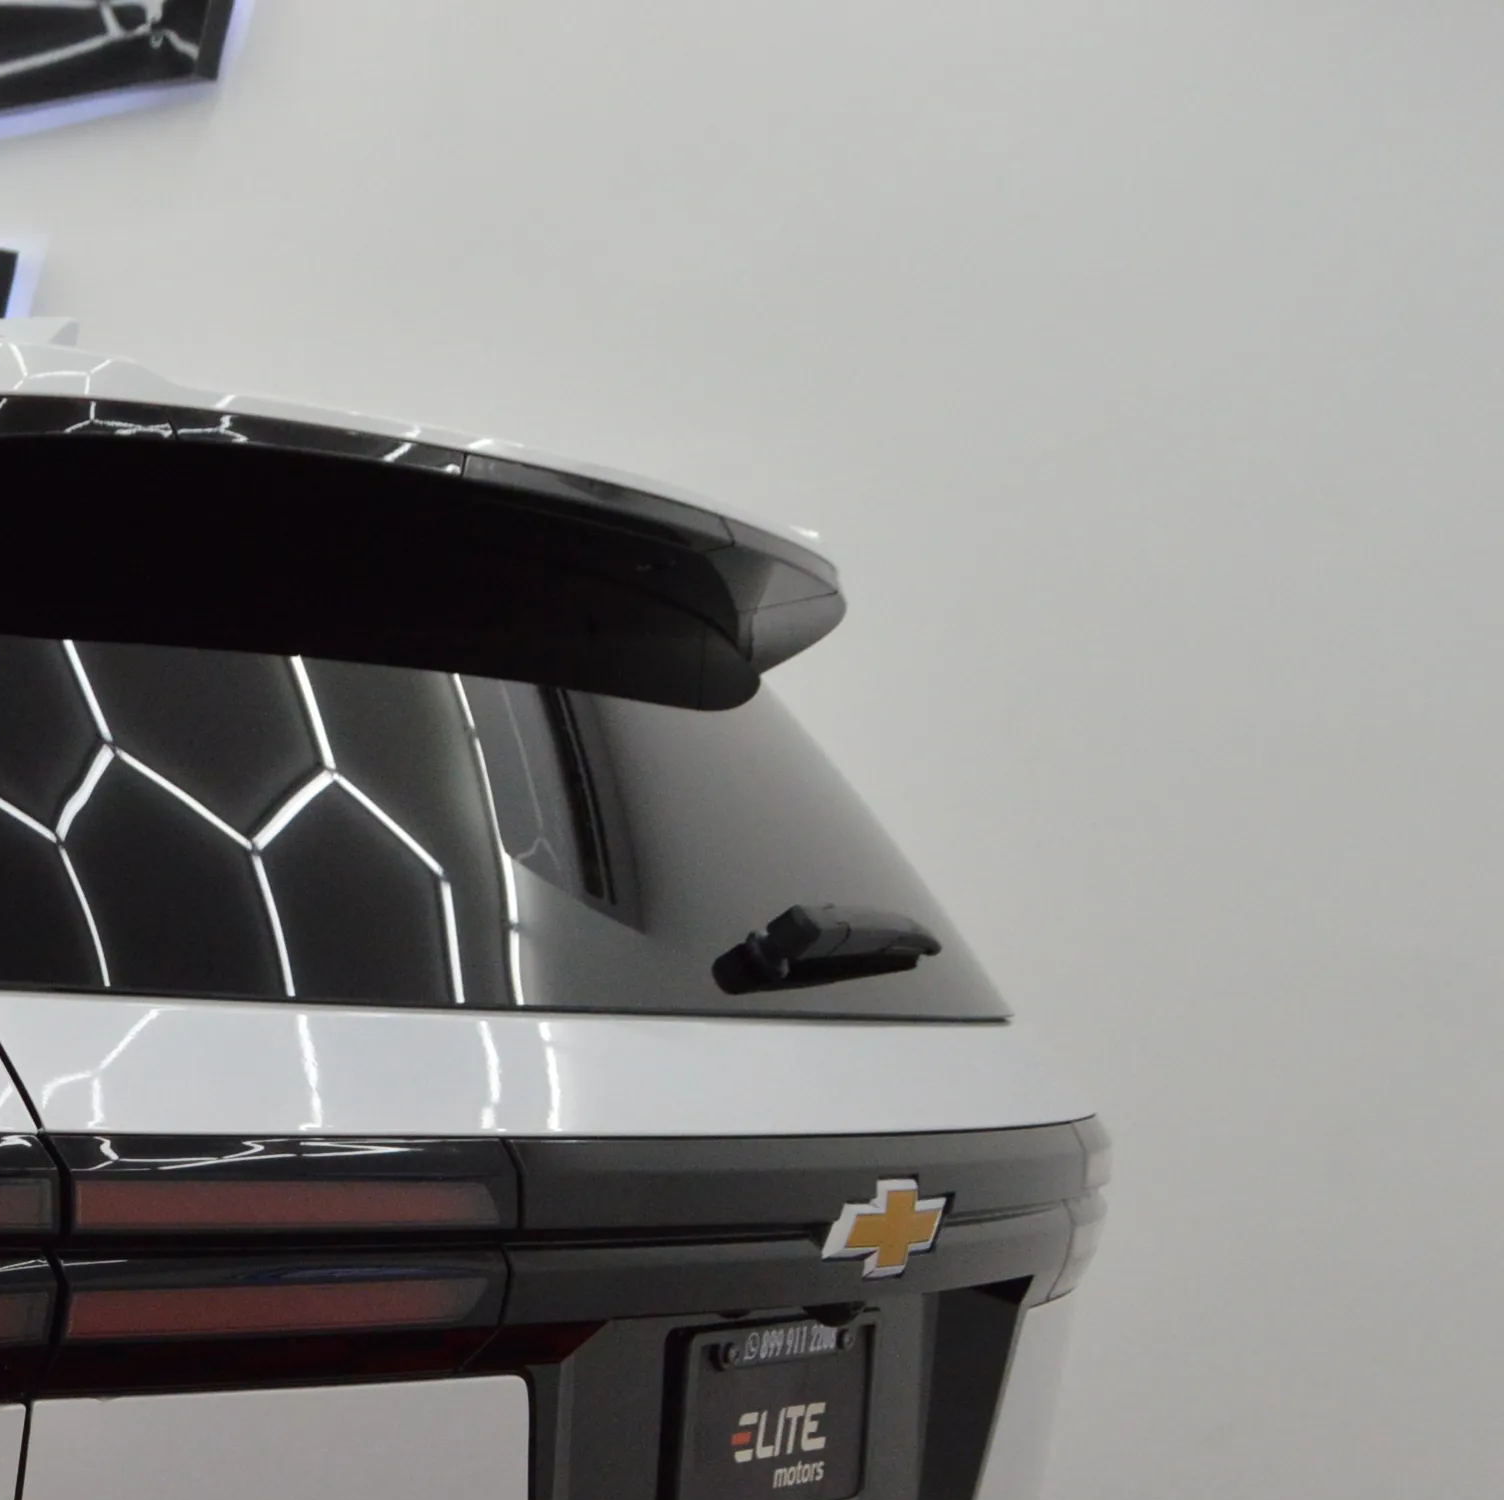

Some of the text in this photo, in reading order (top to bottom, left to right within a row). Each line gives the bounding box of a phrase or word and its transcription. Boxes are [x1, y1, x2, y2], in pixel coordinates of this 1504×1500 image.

[759, 1328, 784, 1360] 899
[786, 1325, 808, 1356] 911
[730, 1402, 827, 1464] ELITE
[772, 1460, 825, 1489] motors
